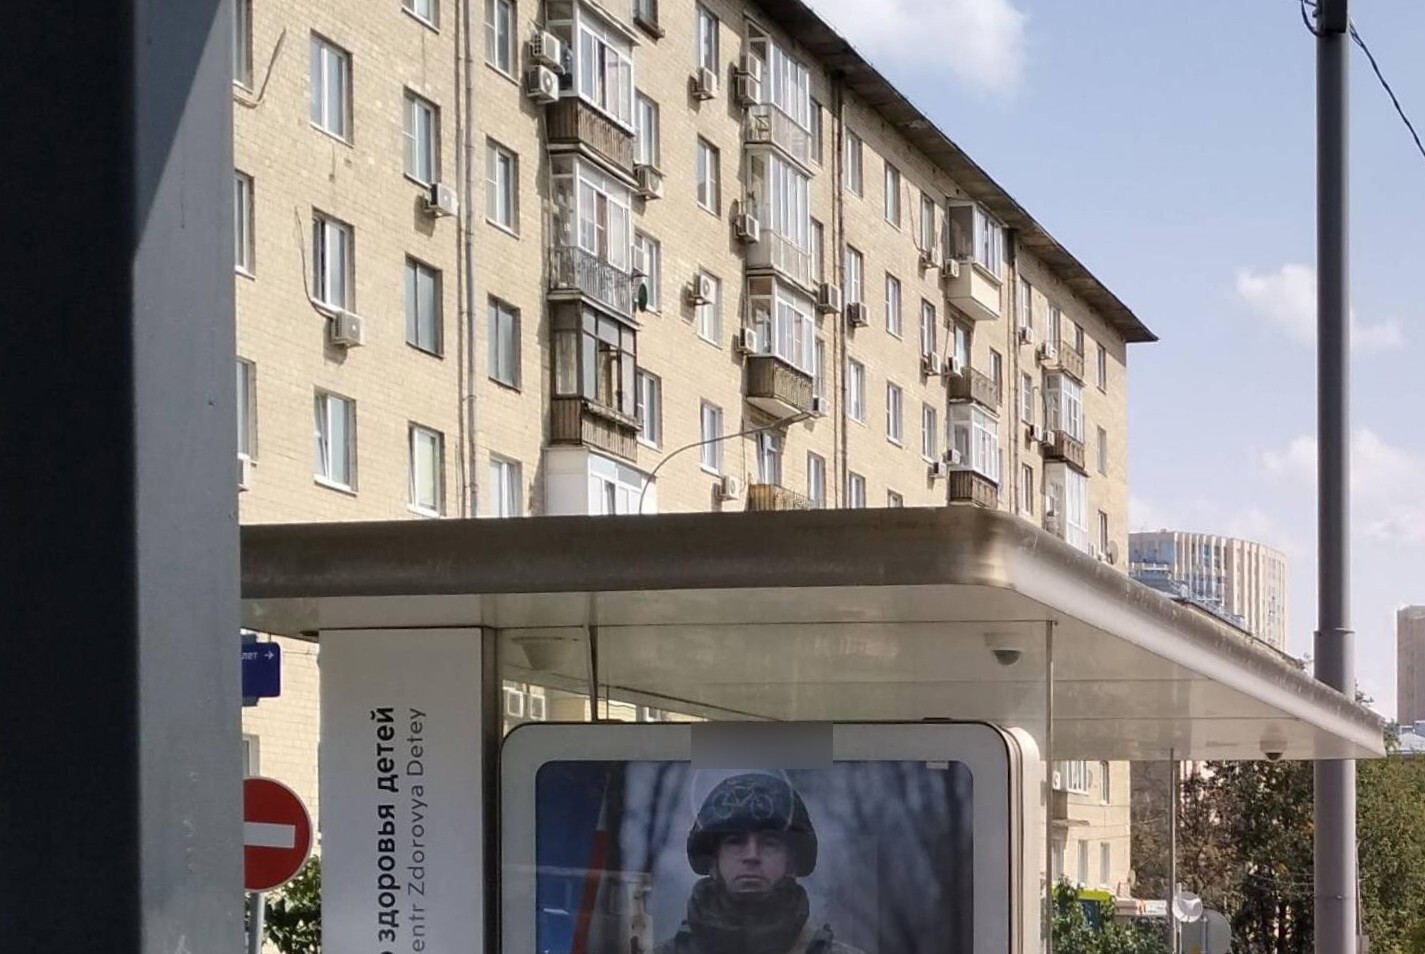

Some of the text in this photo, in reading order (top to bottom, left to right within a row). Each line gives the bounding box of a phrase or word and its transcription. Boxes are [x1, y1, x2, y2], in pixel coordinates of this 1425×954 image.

[371, 707, 399, 793] детей
[406, 708, 426, 776] Detey
[377, 804, 401, 942] здоровья
[407, 785, 428, 896] Zdorovya
